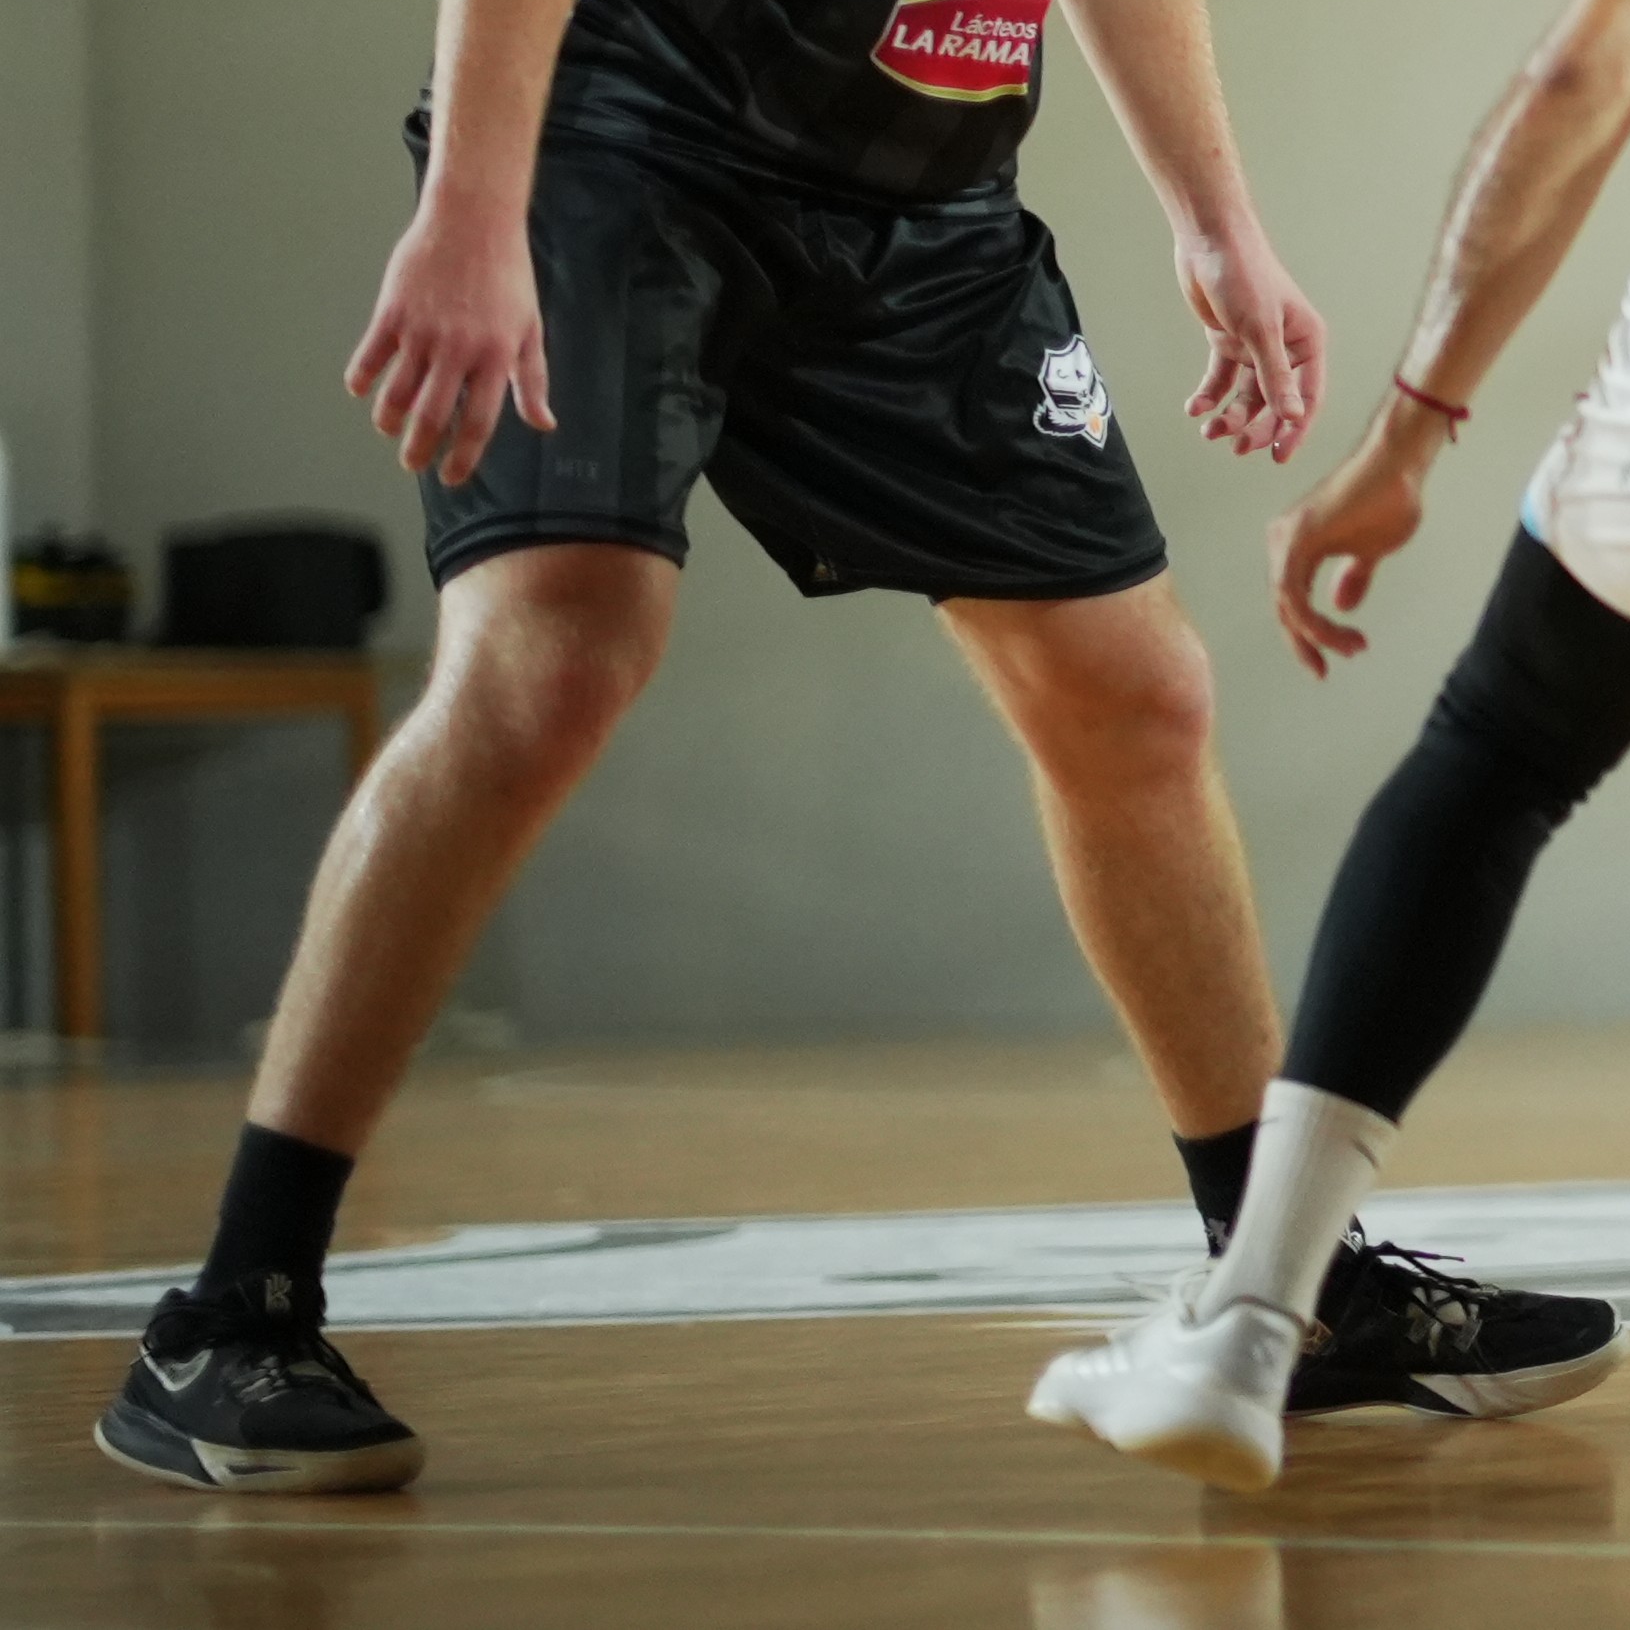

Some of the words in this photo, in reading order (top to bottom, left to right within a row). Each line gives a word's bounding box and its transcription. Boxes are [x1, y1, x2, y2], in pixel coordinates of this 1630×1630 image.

[950, 10, 1039, 40] Lácteos
[892, 23, 935, 55] LA
[936, 33, 1032, 67] RAMA
